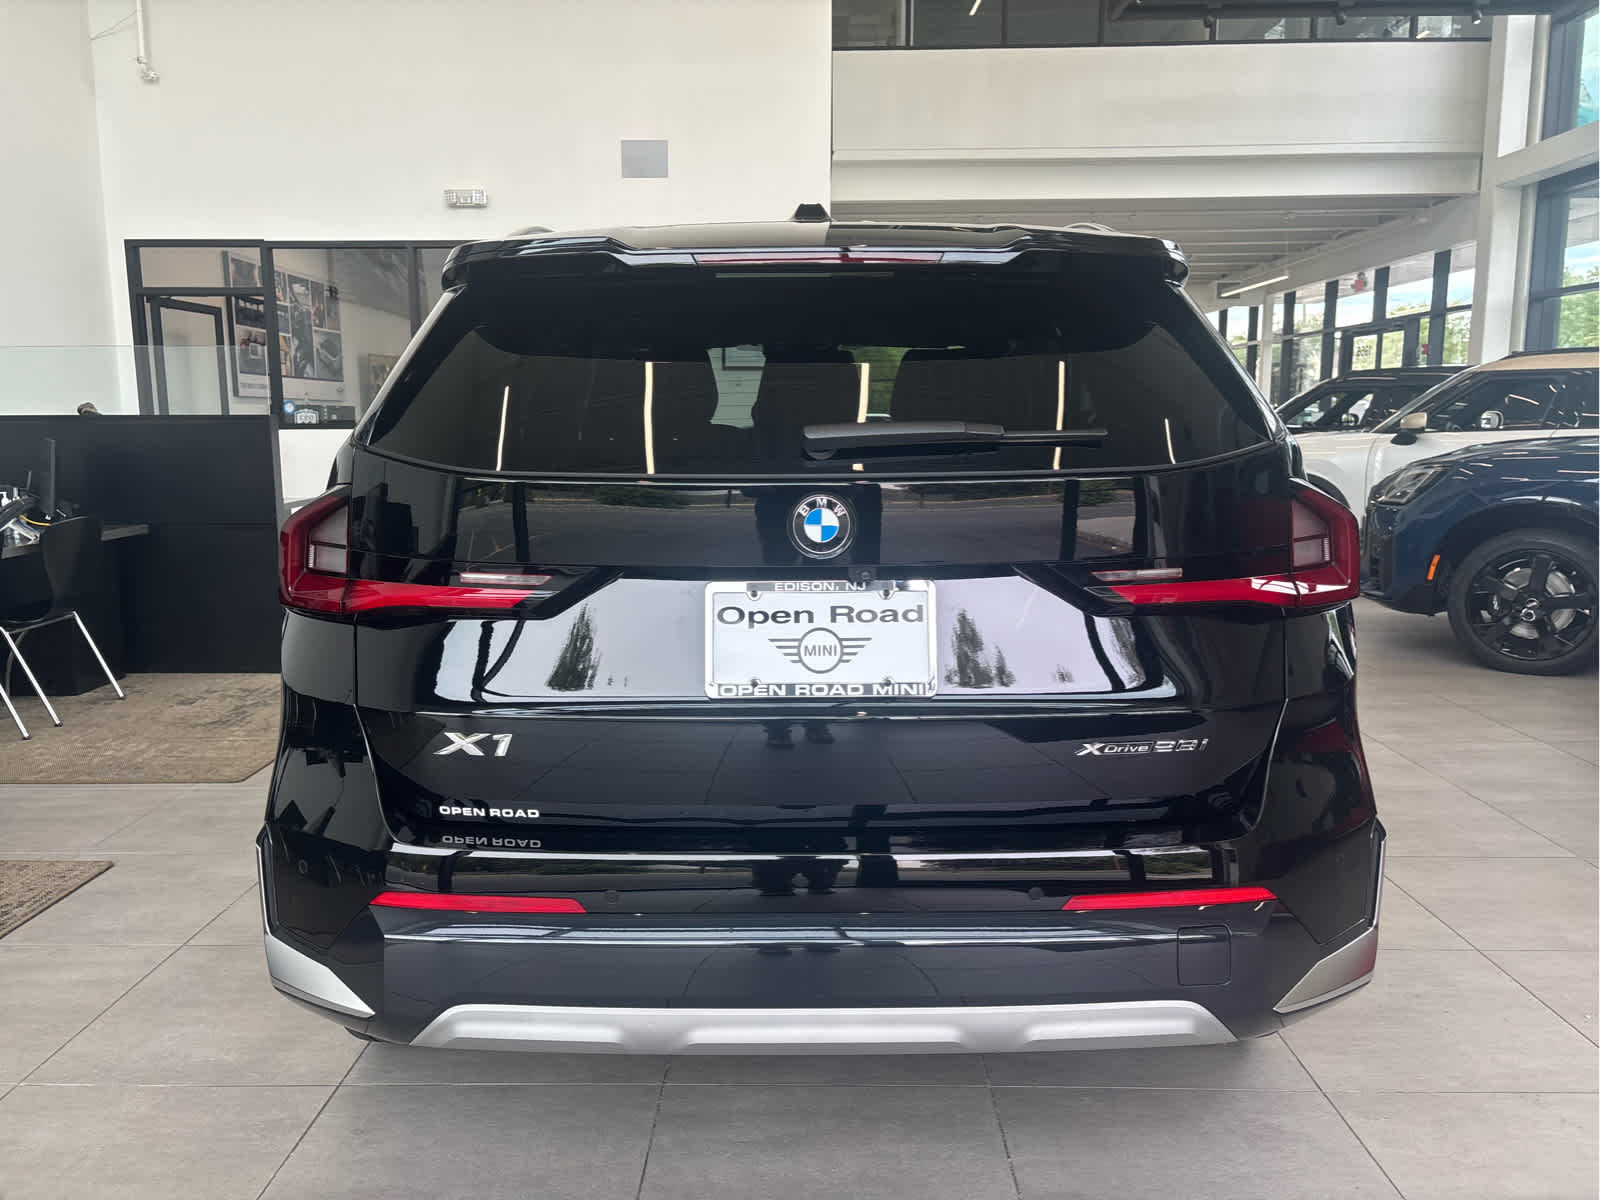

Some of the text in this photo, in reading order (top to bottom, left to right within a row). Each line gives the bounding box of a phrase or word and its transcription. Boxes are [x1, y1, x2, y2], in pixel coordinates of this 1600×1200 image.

[797, 498, 846, 517] BMW
[774, 582, 866, 592] EDISON, NJ
[717, 604, 924, 629] Open Road
[803, 644, 838, 657] MINI
[720, 684, 926, 697] OPEN ROAD MINI
[432, 732, 513, 757] X1
[439, 806, 540, 818] OPEN ROAD
